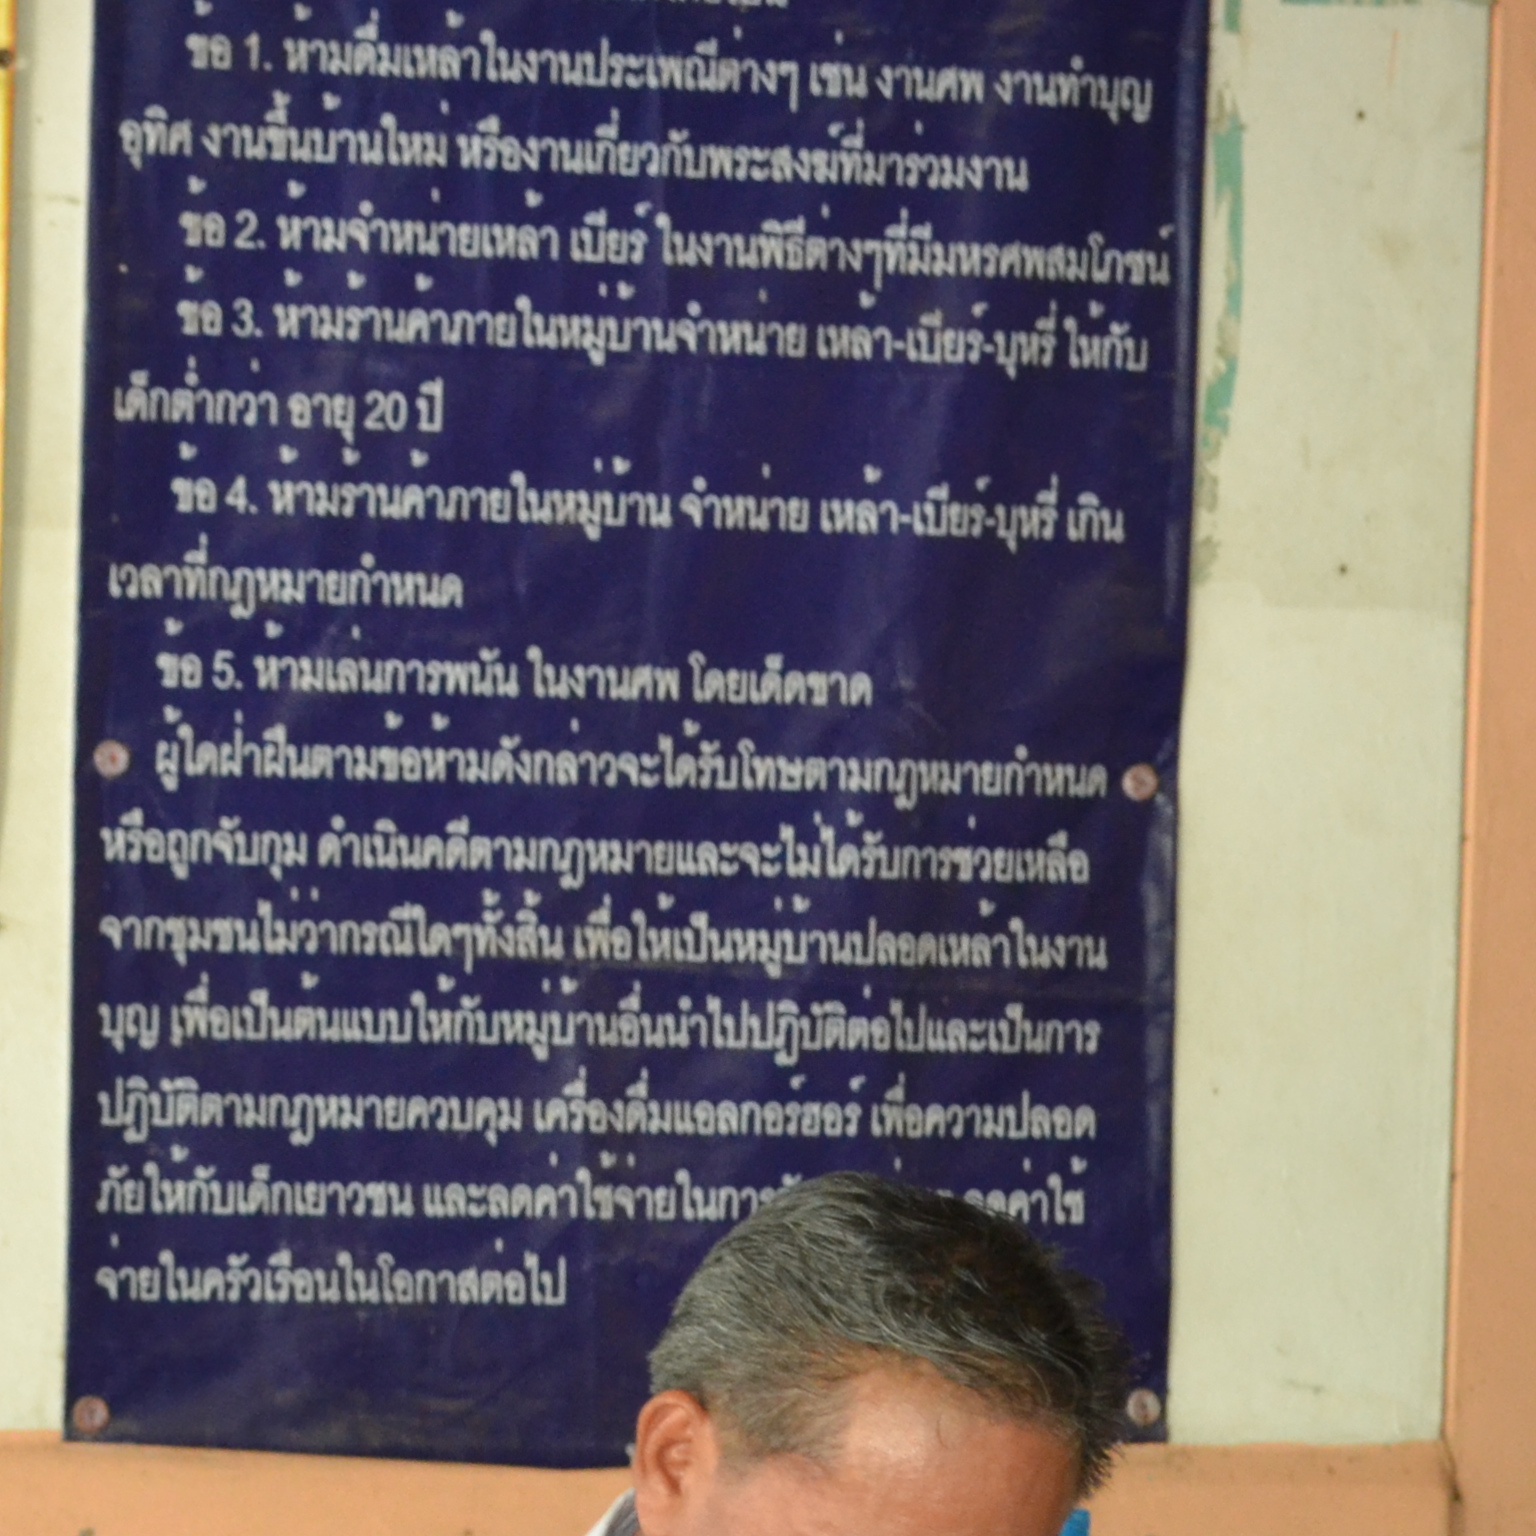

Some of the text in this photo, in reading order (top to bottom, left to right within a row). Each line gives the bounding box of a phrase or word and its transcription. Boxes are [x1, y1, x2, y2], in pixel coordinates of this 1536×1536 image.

[245, 32, 272, 70] 1.
[809, 30, 868, 98] เช่น
[875, 65, 984, 103] งานศพ
[993, 56, 1152, 124] งานทำบุญ
[119, 104, 192, 170] อุทิศ
[179, 175, 226, 248] ข้อ
[234, 209, 265, 249] 2.
[570, 202, 652, 264] เบียร์
[176, 264, 222, 336] ข้อ
[232, 298, 263, 337] 3.
[364, 390, 408, 432] 20
[416, 377, 444, 433] ปี
[170, 441, 217, 513] ข้อ
[225, 475, 258, 514] 4.
[1067, 491, 1124, 543] เกิน
[155, 617, 202, 689] ข้อ
[212, 650, 242, 690] 5.
[253, 620, 520, 698] ห้ามเล่นการพนัน
[688, 651, 873, 706] โดยเด็ดขาด
[100, 807, 308, 880] หรือถูกจับกุม
[98, 1003, 160, 1053] บุญ
